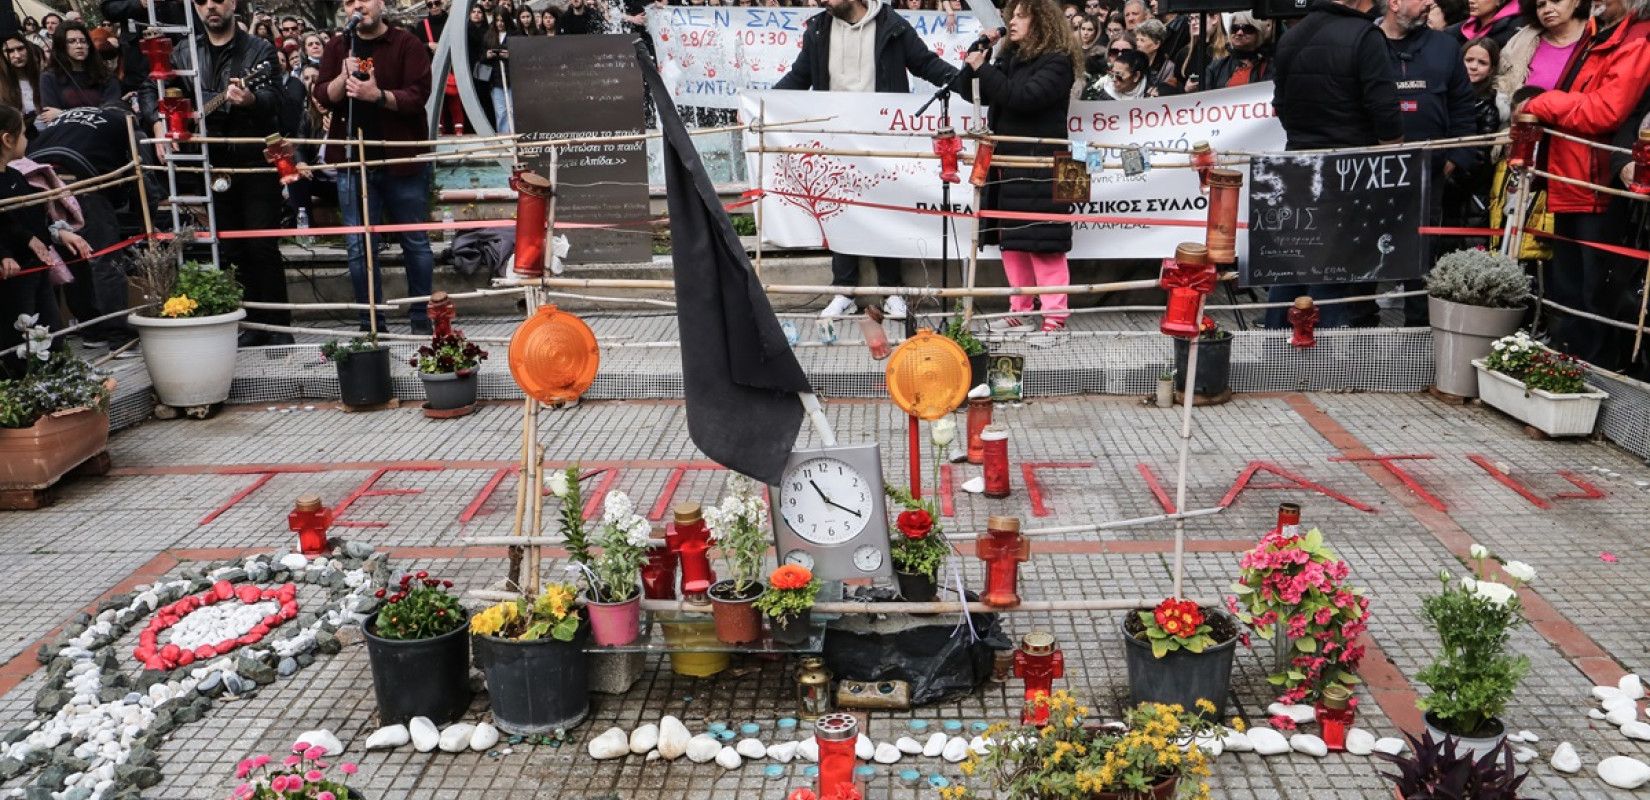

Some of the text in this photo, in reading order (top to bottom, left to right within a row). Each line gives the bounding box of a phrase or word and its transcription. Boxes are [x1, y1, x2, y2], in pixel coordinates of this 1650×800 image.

[671, 8, 729, 27] ΔΕΝ
[746, 9, 799, 31] ΣΑΣ
[681, 29, 788, 47] 28/2 10:30
[1092, 112, 1120, 132] δε
[604, 144, 615, 152] το
[617, 140, 644, 152] παιδί
[1250, 154, 1411, 204] 57 ΨΥΧΕΣ
[1146, 196, 1208, 212] ΣΥΛΛΟ
[818, 463, 828, 472] 12
[838, 467, 843, 475] 1
[803, 470, 811, 478] 11
[793, 482, 802, 491] 10
[852, 478, 858, 487] 2
[860, 492, 865, 502] 3
[789, 498, 796, 508] 9
[798, 514, 805, 523] 8
[811, 524, 818, 533] 7
[844, 521, 850, 530] 5
[828, 527, 835, 536] 6
